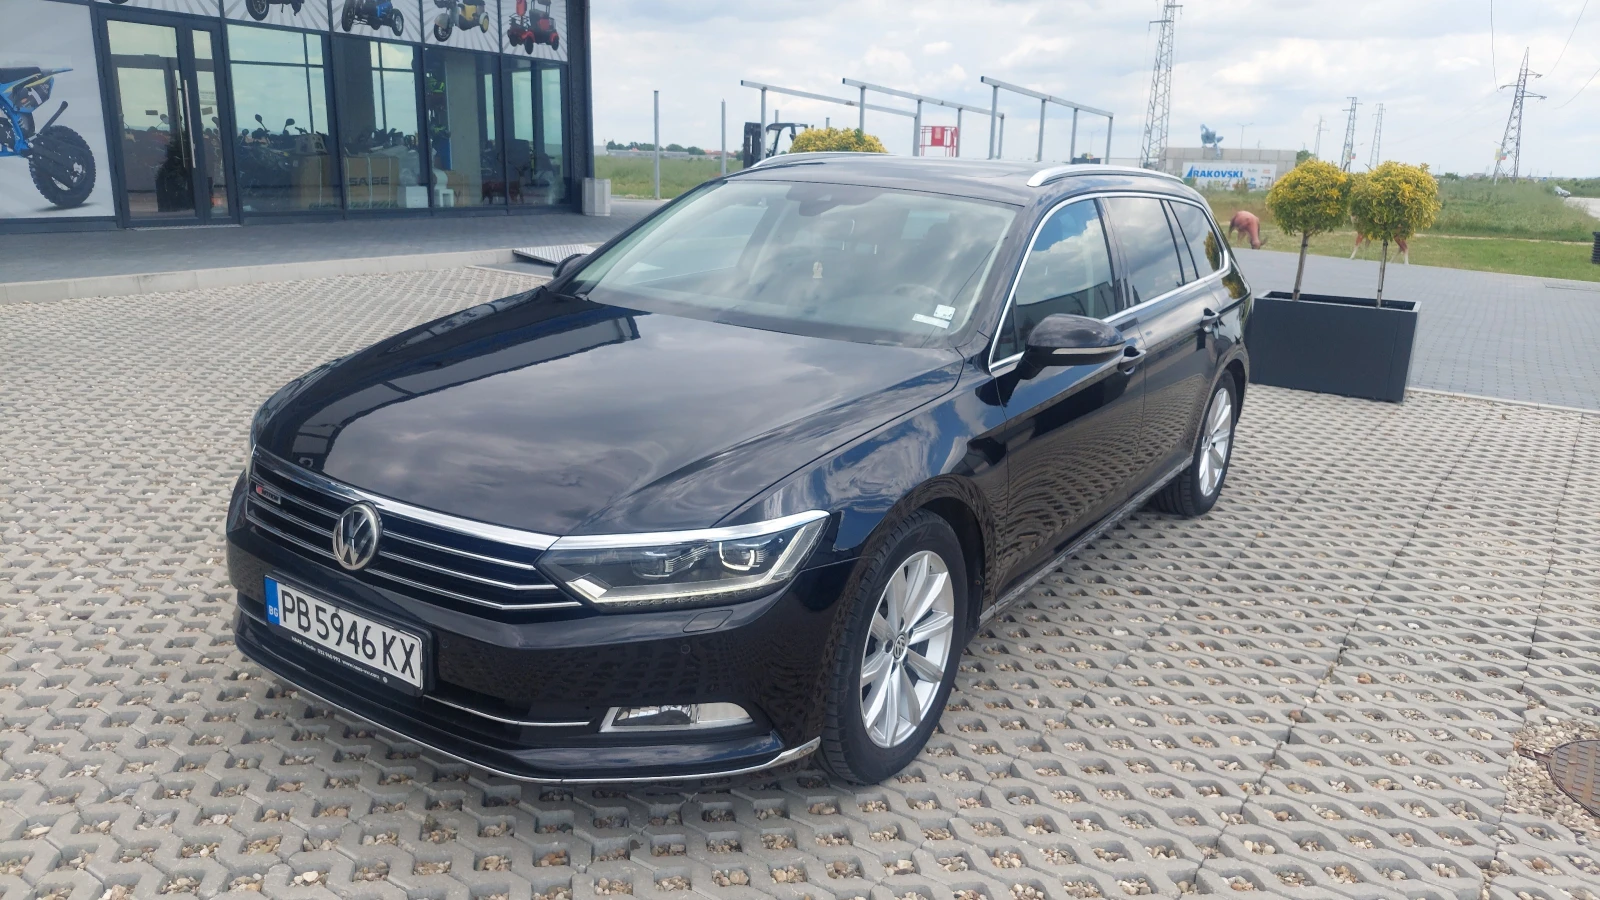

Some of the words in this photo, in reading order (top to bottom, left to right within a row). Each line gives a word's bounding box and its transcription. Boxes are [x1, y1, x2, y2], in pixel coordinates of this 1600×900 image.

[1192, 169, 1243, 178] RAKOVSKI
[268, 604, 279, 618] BG
[281, 589, 312, 633] PB
[314, 604, 377, 660] 5946
[381, 631, 416, 680] KX
